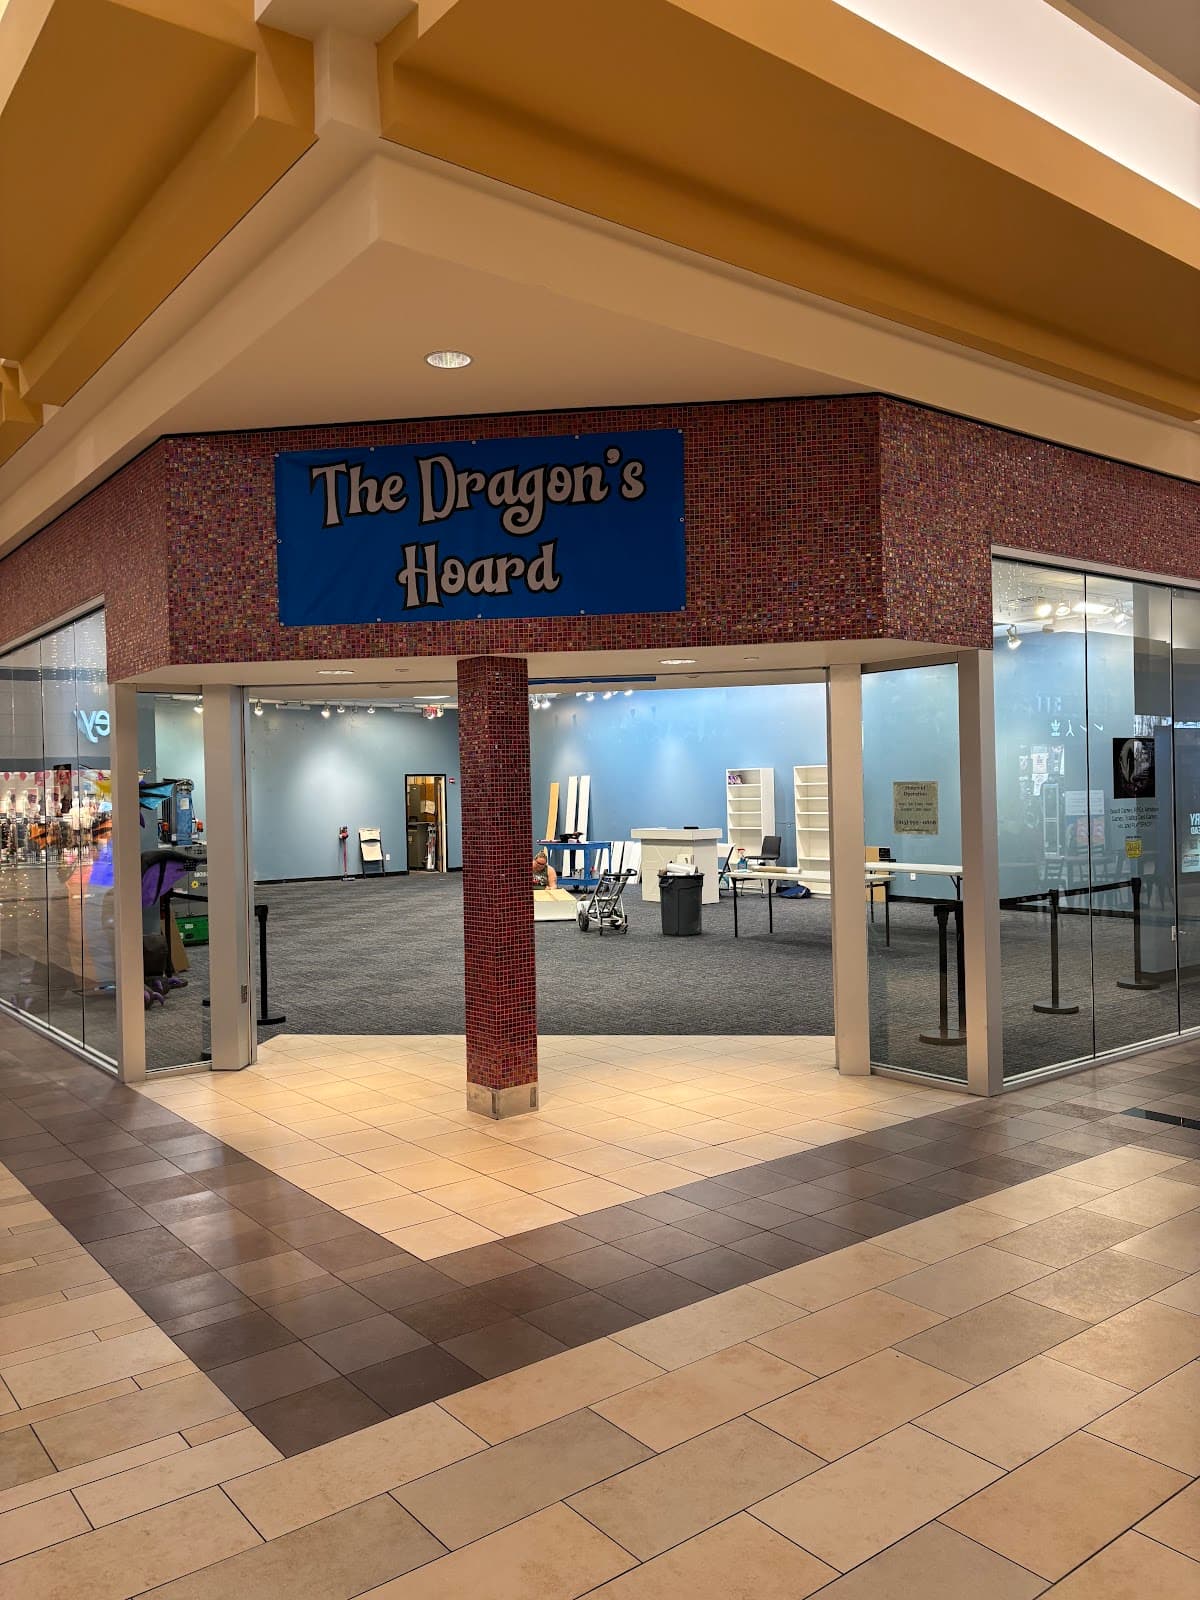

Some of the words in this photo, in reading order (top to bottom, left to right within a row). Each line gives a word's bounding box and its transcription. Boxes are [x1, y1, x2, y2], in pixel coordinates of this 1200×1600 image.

[309, 459, 407, 528] The
[414, 446, 647, 536] Dragon's
[397, 538, 562, 609] Hoard
